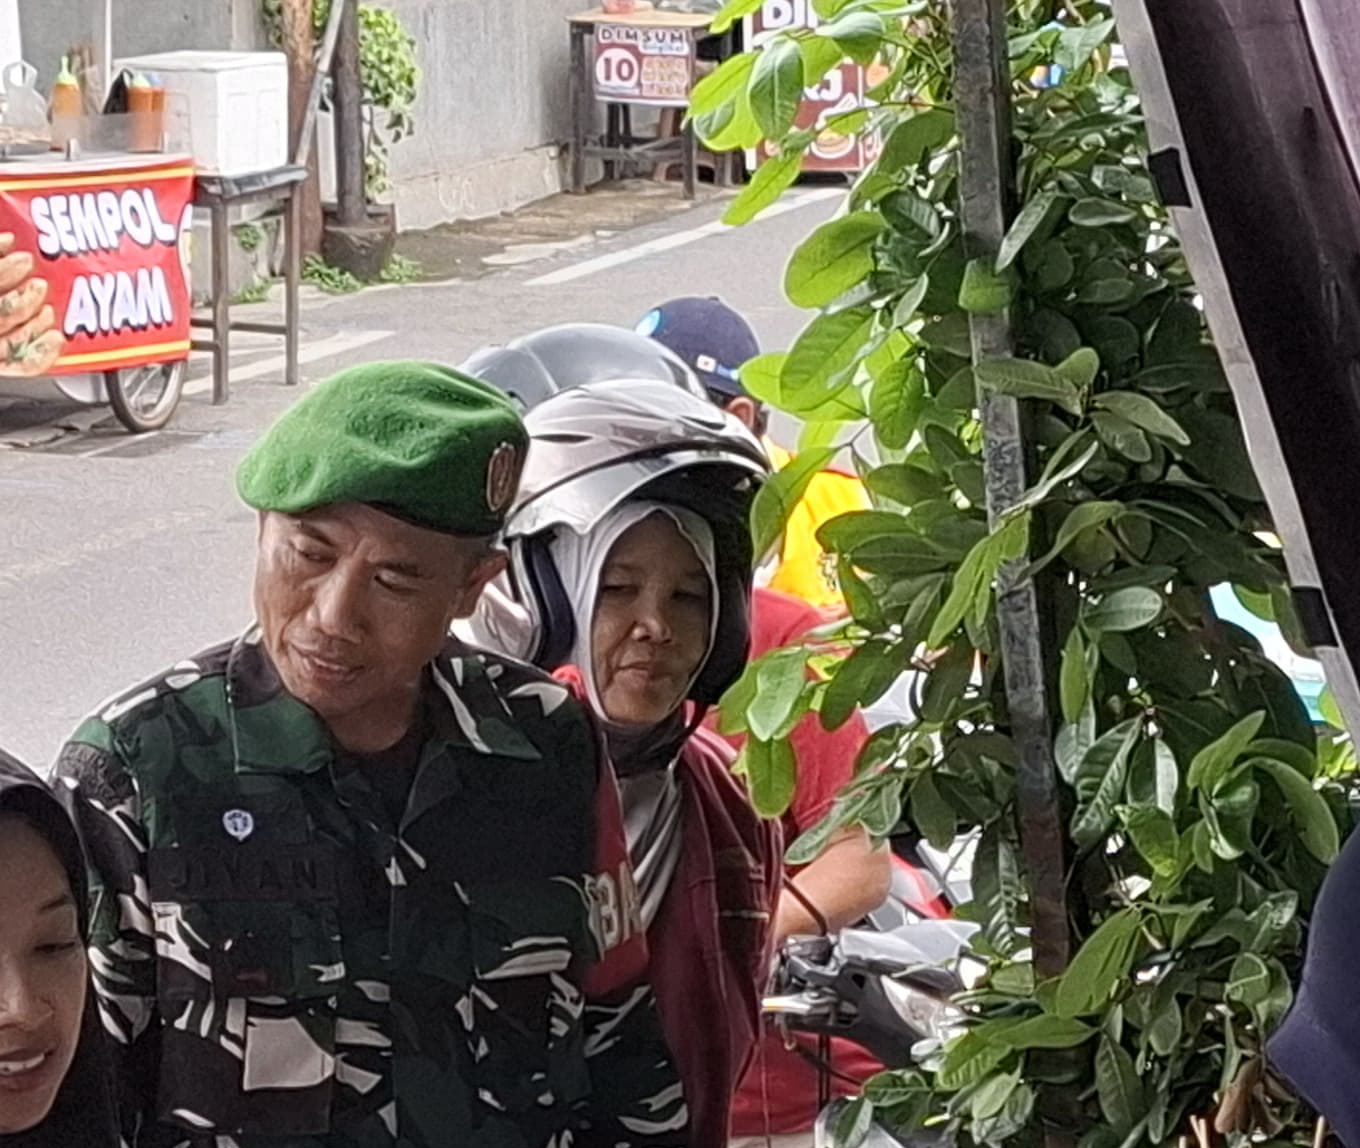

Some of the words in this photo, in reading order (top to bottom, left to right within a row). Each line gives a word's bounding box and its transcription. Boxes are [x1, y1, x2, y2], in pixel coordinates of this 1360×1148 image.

[601, 23, 687, 45] DIMSUM
[602, 57, 635, 82] 10
[30, 187, 177, 256] SEMPOL
[63, 265, 174, 336] AYAM
